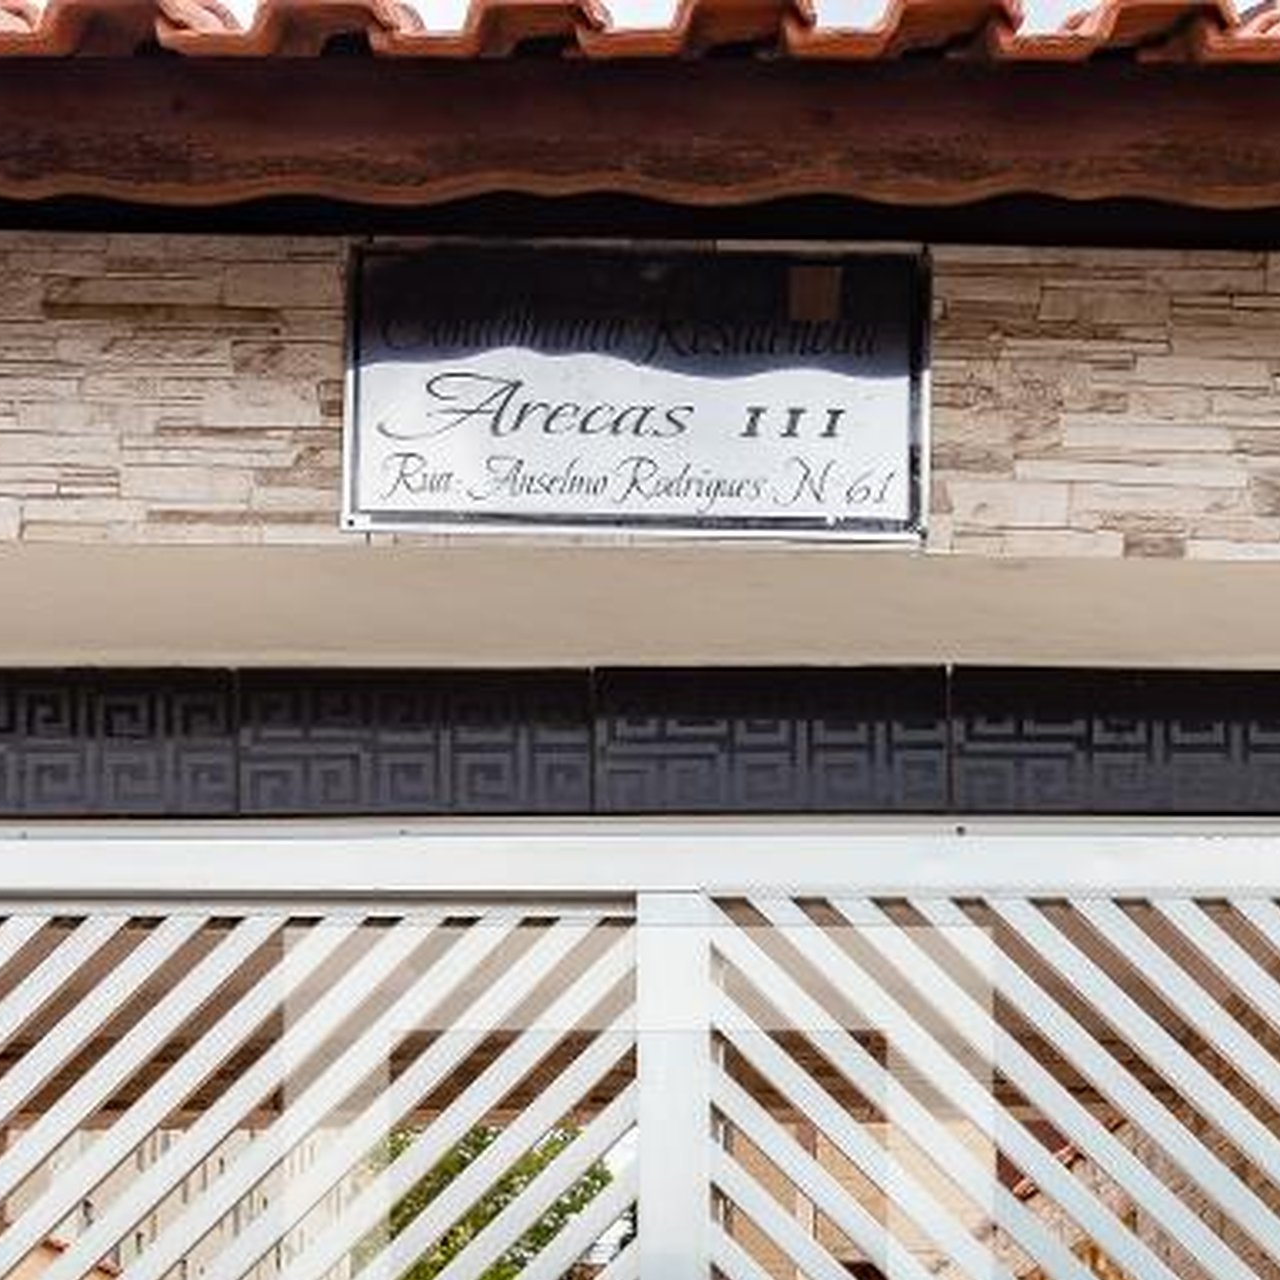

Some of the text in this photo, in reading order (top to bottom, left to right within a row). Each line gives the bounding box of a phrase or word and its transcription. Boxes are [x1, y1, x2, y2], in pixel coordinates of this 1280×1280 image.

[376, 372, 847, 440] Arecas III
[467, 454, 608, 501] Anselmo
[613, 456, 768, 514] Rodrigues
[845, 464, 896, 504] 61
